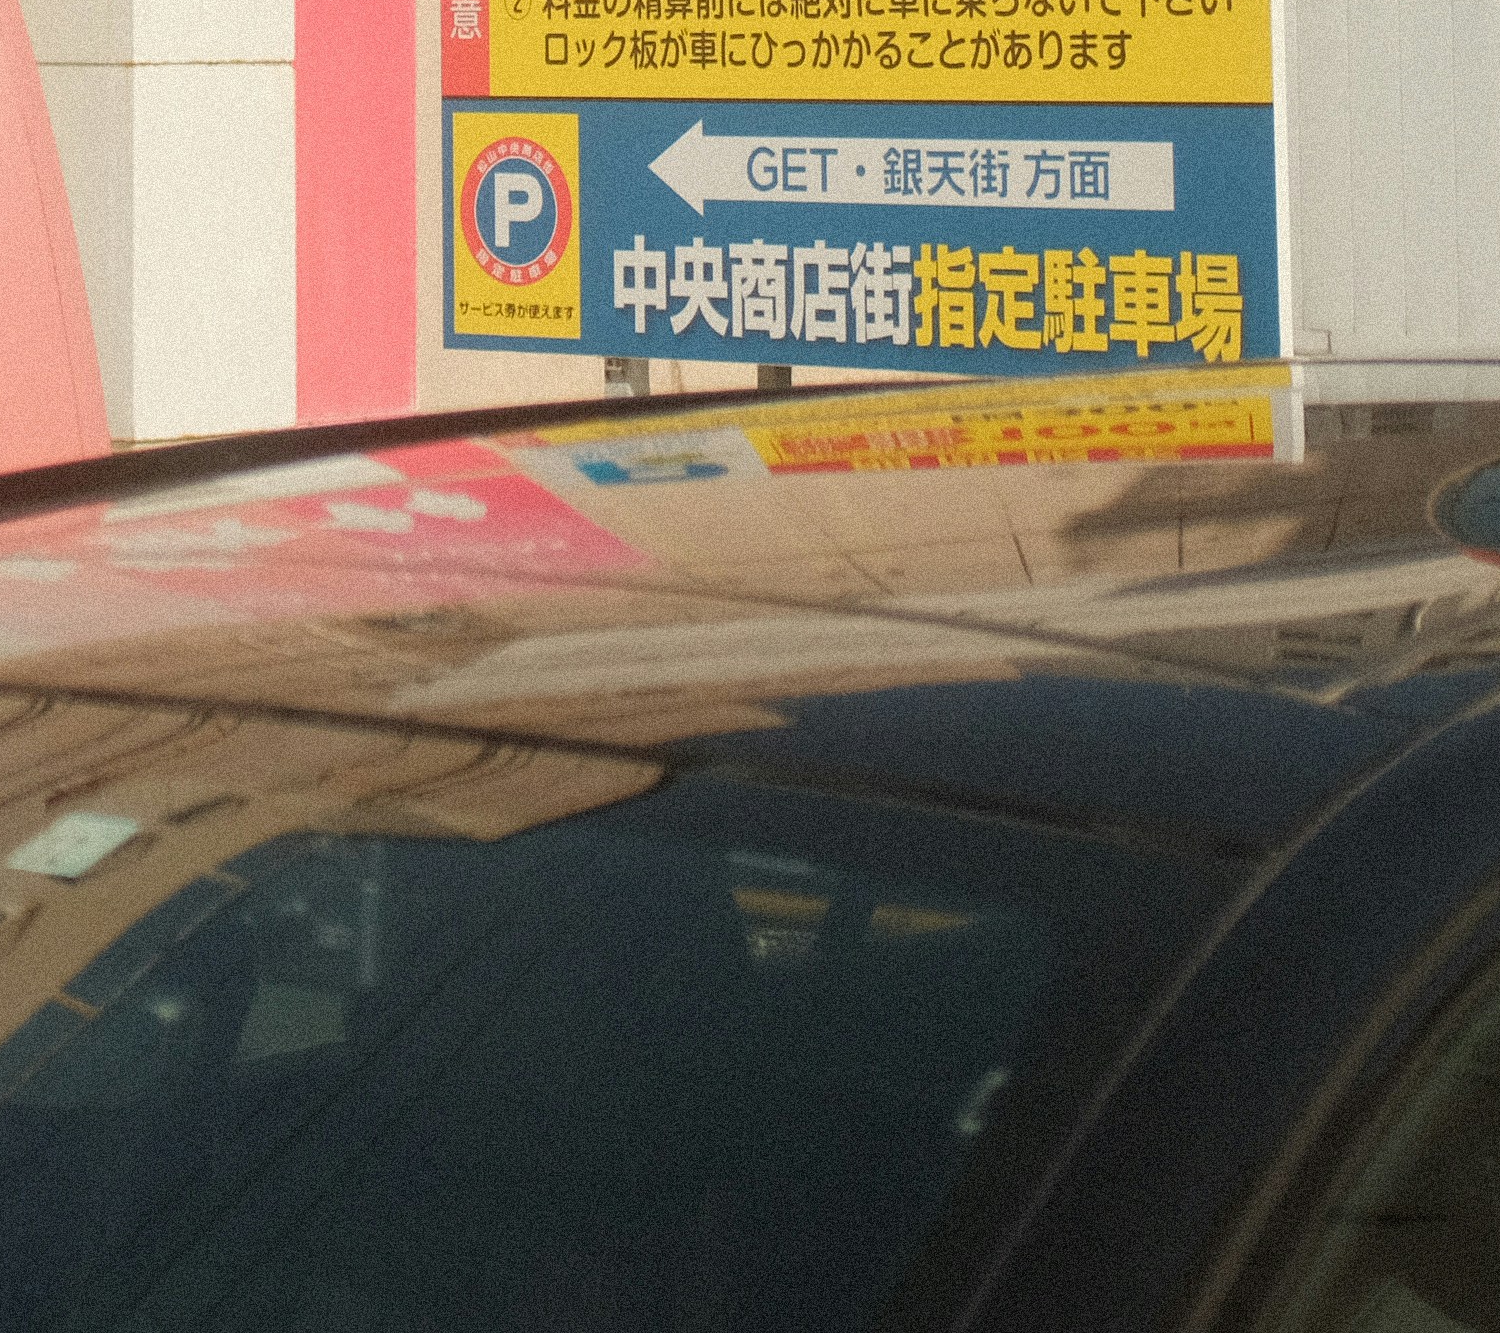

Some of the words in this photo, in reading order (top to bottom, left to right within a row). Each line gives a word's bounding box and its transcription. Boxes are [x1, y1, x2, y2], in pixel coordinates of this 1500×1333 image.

[544, 27, 1133, 71] ロック板が車にひっかかることがあります
[1024, 147, 1110, 203] 方面
[494, 172, 544, 248] P
[458, 301, 575, 321] サービス券が使えます
